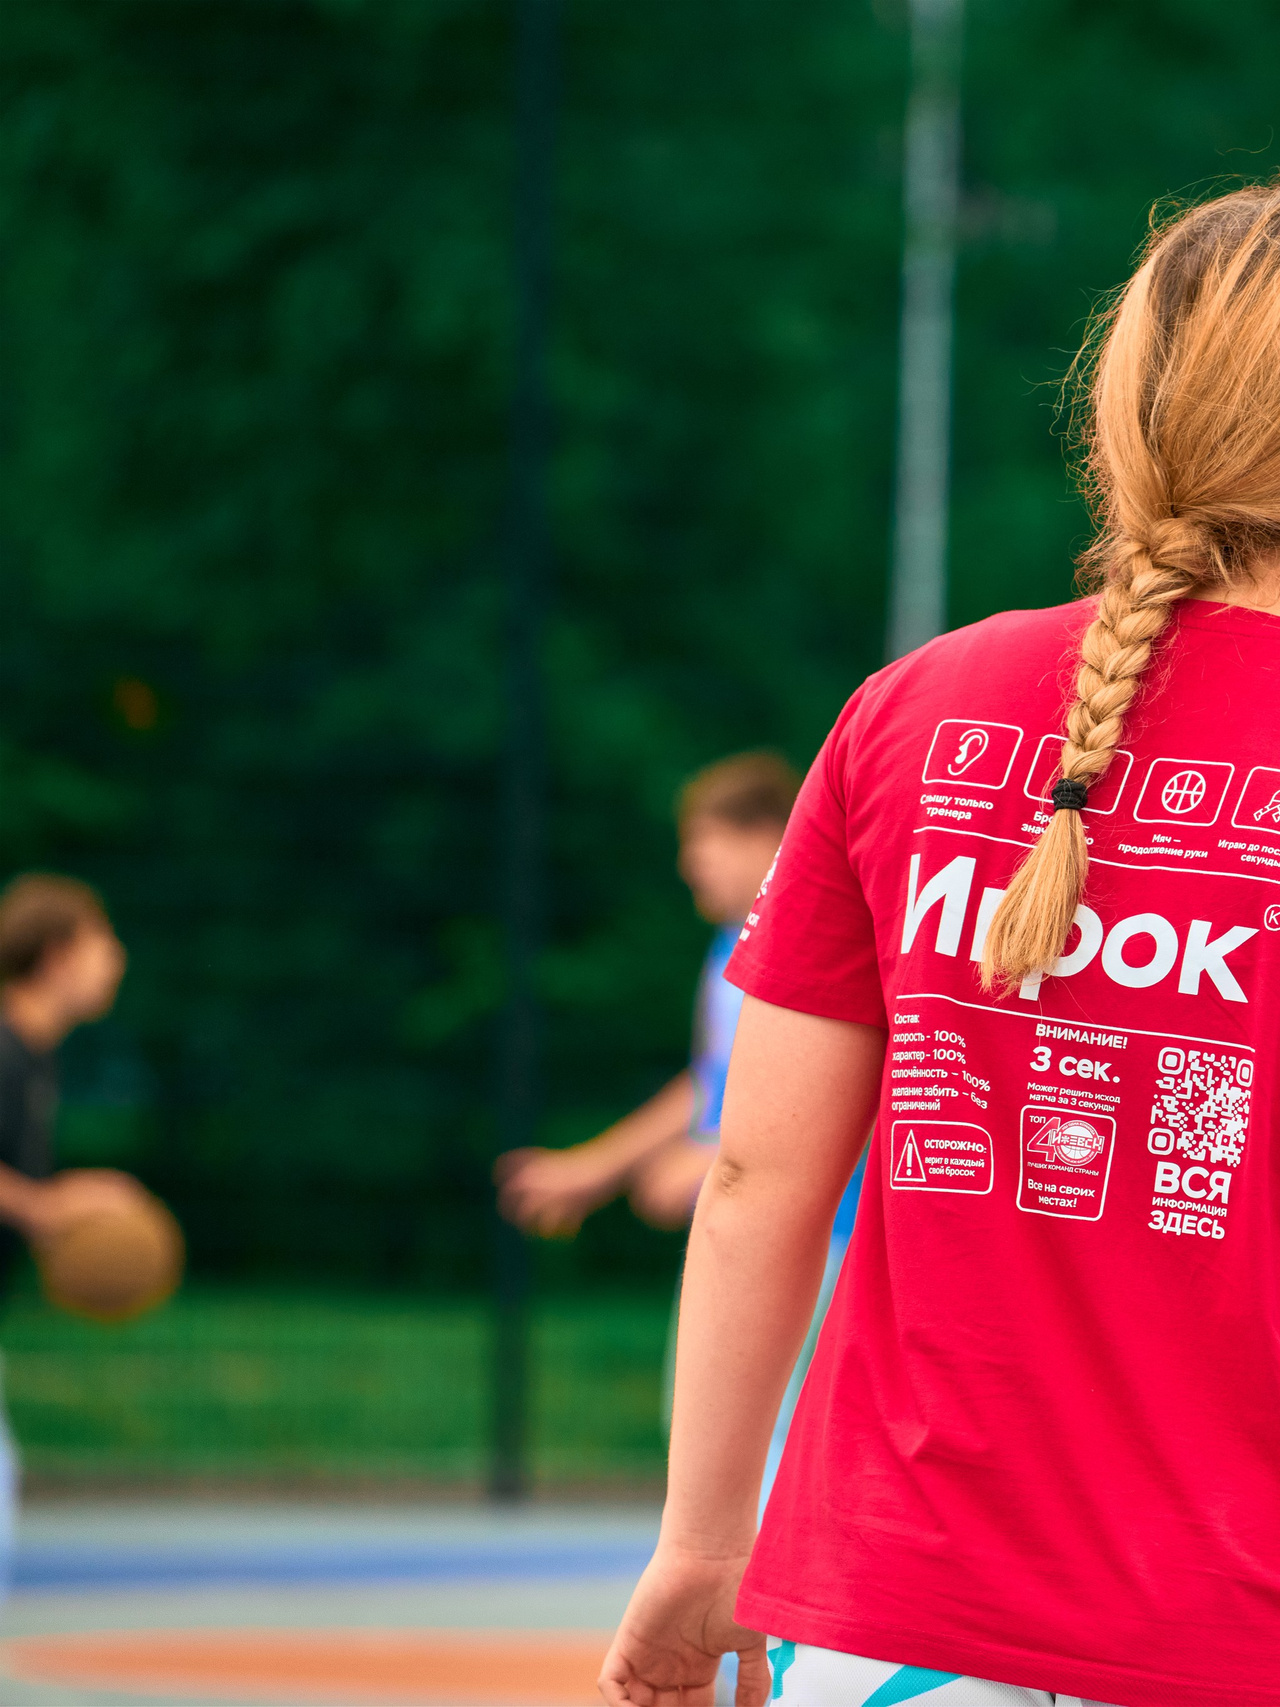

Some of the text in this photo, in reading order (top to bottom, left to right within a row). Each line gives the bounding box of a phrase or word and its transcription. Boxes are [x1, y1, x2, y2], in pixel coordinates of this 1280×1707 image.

[954, 797, 994, 810] только
[926, 807, 972, 820] тренера
[1152, 833, 1172, 843] Мяч
[1218, 839, 1246, 850] Играю
[1118, 844, 1208, 859] продолжение руки
[894, 1013, 920, 1024] Состав:
[893, 1032, 925, 1044] скорость
[933, 1029, 966, 1048] 100%
[1035, 1023, 1128, 1049] ВНИМАНИЕ!
[892, 1050, 925, 1063] характер
[932, 1048, 966, 1064] 100%
[1029, 1046, 1120, 1083] 3 сек.
[891, 1066, 948, 1078] сплочённость
[962, 1070, 991, 1092] 100%
[891, 1086, 923, 1096] желание
[924, 1084, 959, 1097] забить
[970, 1091, 988, 1109] без
[1027, 1082, 1121, 1103] Может решить исход
[891, 1099, 940, 1113] ограничений
[1029, 1093, 1115, 1112] матча за 3 секунды
[1029, 1115, 1046, 1124] ТОП
[924, 1139, 987, 1153] ОСТОРОЖНО:
[925, 1156, 985, 1168] верит в каждый
[929, 1166, 975, 1177] свой бросок
[1048, 1164, 1074, 1173] КОМАНД
[1074, 1167, 1099, 1176] СТРАНЫ
[1027, 1178, 1096, 1198] Все на своих
[1154, 1161, 1232, 1204] ВСЯ
[1151, 1196, 1228, 1217] ИНФОРМАЦИЯ
[1147, 1210, 1225, 1240] ЗДЕСЬ
